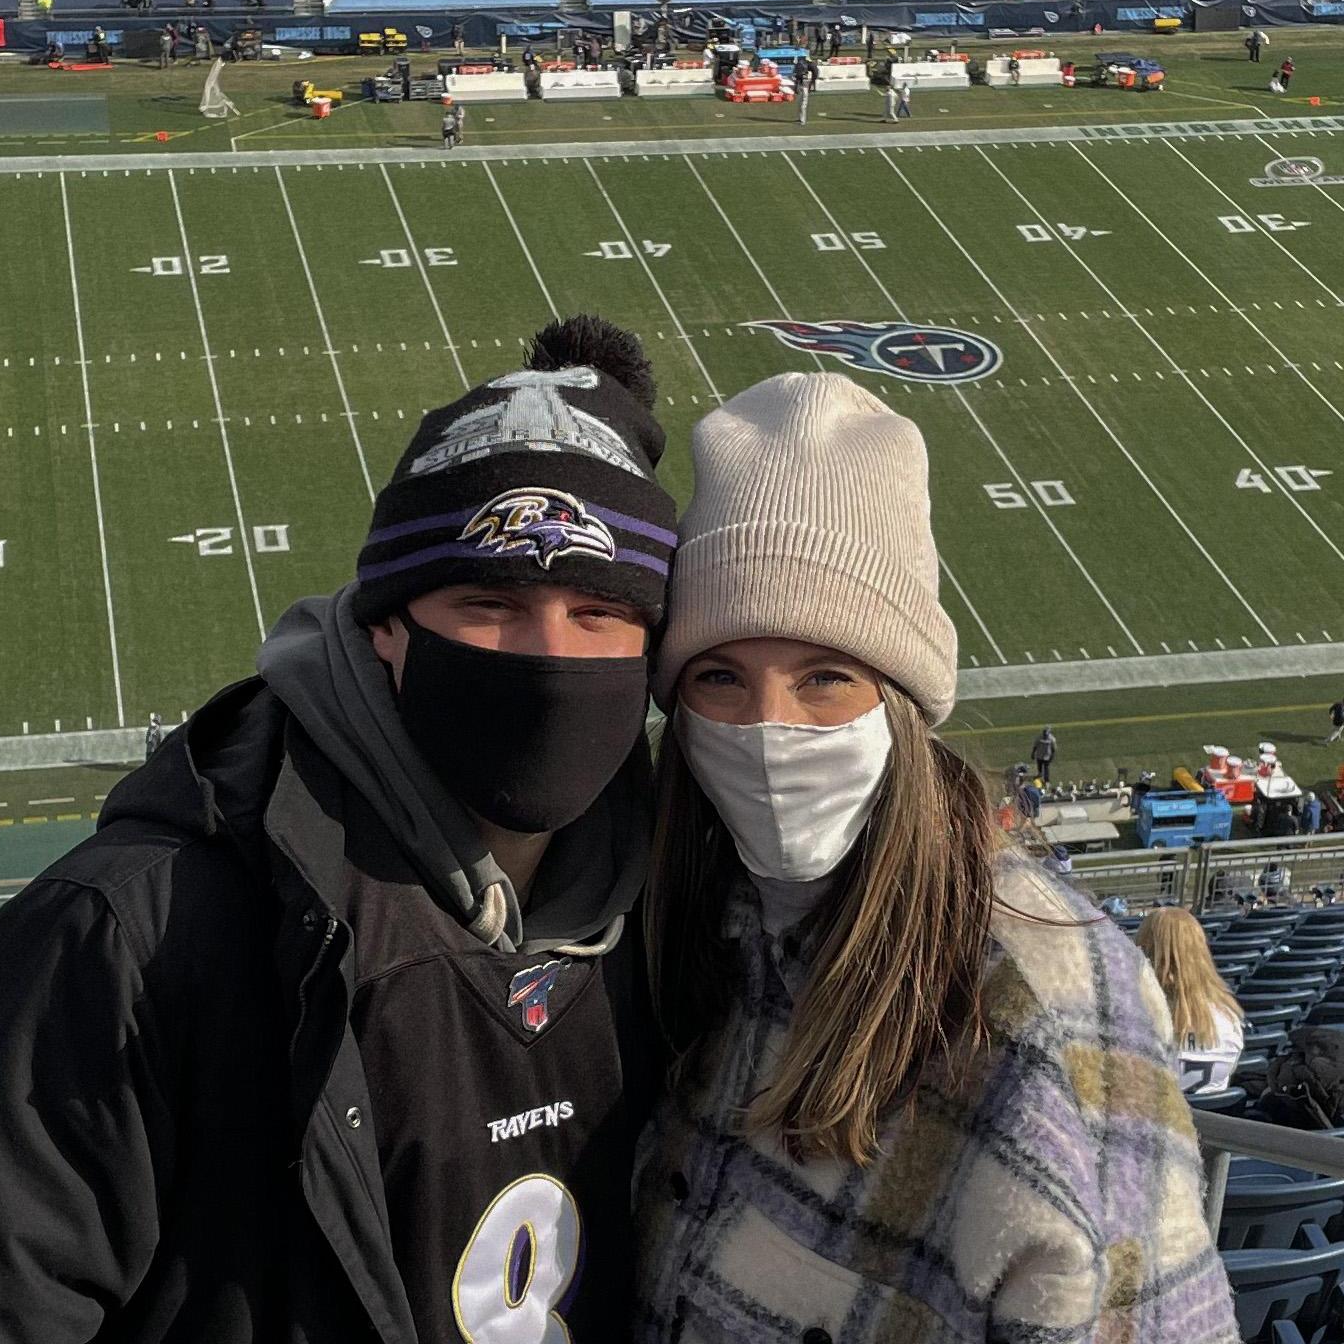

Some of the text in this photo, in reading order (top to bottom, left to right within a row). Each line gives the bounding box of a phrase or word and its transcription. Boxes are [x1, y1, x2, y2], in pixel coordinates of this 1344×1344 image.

[1082, 122, 1240, 139] INSPIRE
[1257, 176, 1305, 186] WILD
[1016, 222, 1087, 242] 40
[1217, 213, 1296, 233] 30
[598, 239, 672, 259] 40
[810, 231, 887, 251] 50
[152, 255, 230, 276] 20
[380, 248, 458, 268] 30
[1235, 465, 1321, 493] 40
[982, 480, 1077, 509] 50
[195, 523, 291, 557] 20
[487, 1100, 574, 1143] RAVENS
